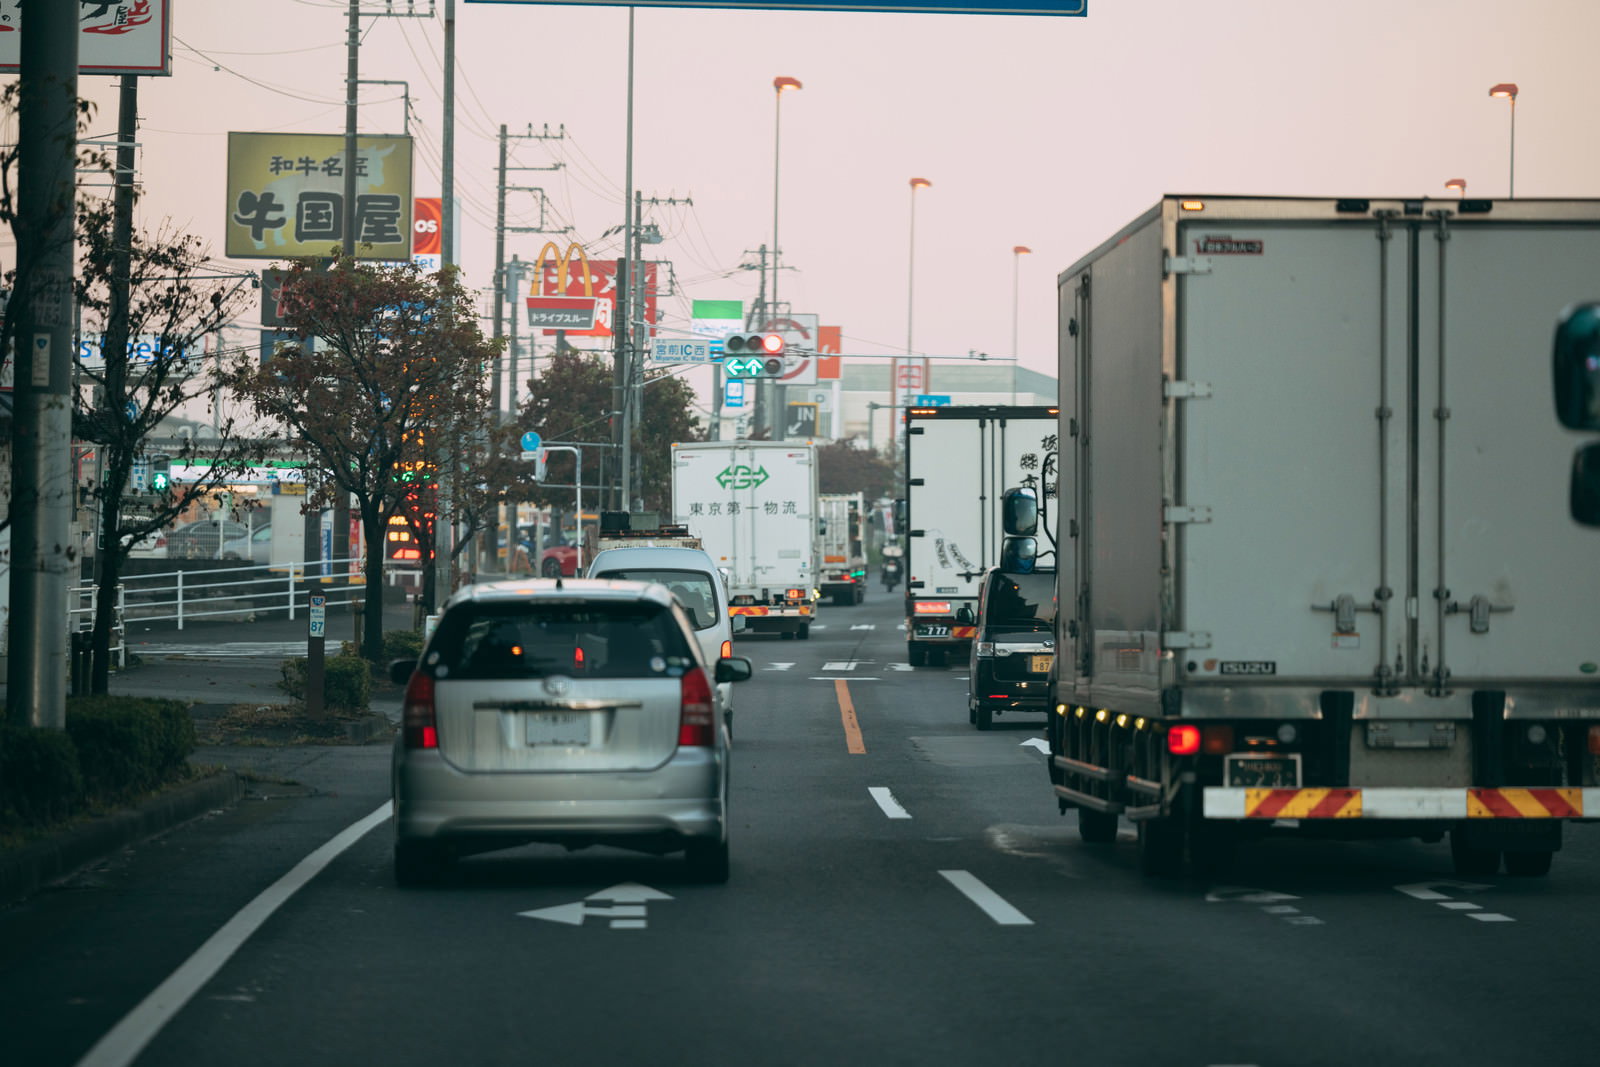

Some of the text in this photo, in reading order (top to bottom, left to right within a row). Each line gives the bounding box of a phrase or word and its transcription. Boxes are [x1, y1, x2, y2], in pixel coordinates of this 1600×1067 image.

[532, 313, 590, 324] ドライブスルー
[656, 344, 705, 356] 宮前IC西
[797, 407, 815, 421] IN
[689, 501, 798, 516] 東京第一物流
[311, 621, 324, 632] 87
[1222, 663, 1274, 674] ISUZU
